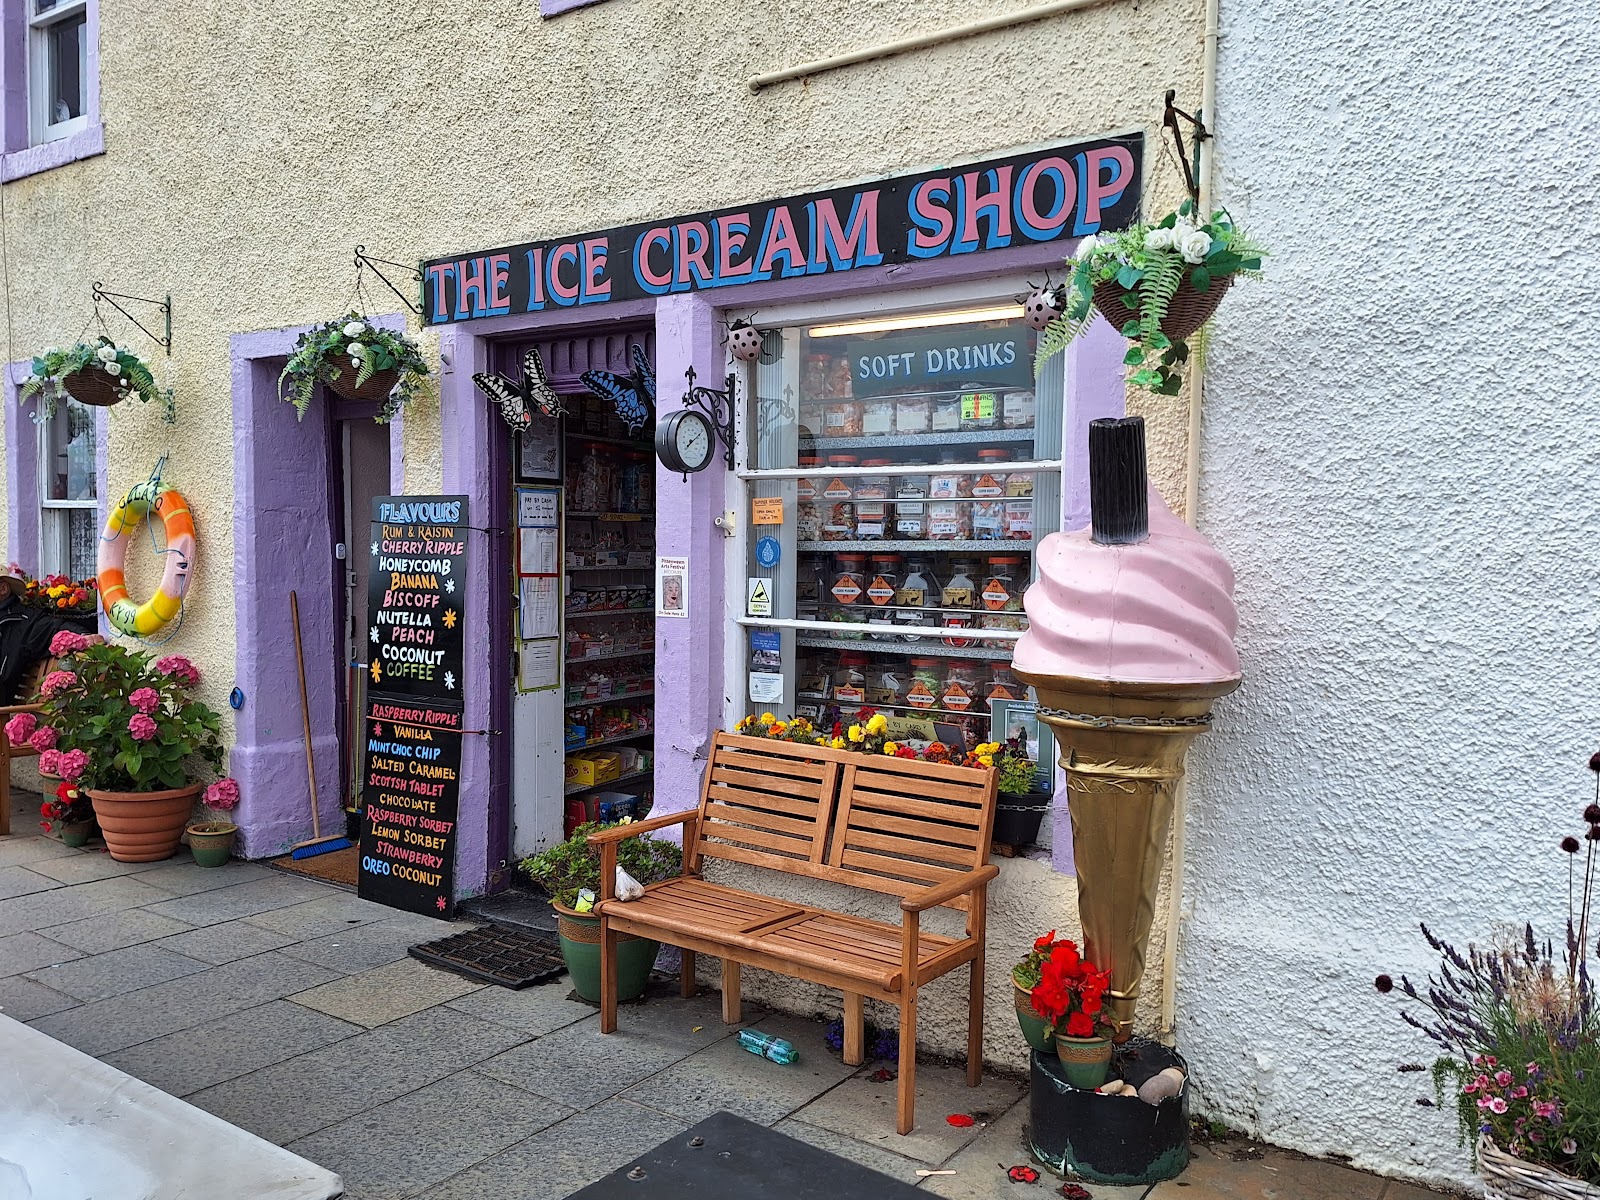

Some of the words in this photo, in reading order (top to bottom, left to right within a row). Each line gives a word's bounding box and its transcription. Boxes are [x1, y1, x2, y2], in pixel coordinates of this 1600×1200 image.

[425, 254, 511, 324] THE
[524, 237, 612, 312] ICE
[632, 188, 884, 294] CREAM
[906, 144, 1135, 258] SHOP
[859, 351, 916, 379] SOFT
[926, 340, 1016, 374] DRINKS
[379, 500, 461, 524] FLAVOURS
[382, 525, 402, 539] RUM
[407, 526, 415, 538] &
[418, 526, 454, 541] RAISIN
[382, 540, 424, 554] CHERRY
[425, 540, 464, 556] RIPPLE
[379, 556, 451, 577] HONEYCOMB
[390, 572, 439, 591] BANANA
[383, 590, 441, 608] BISCOFF
[377, 610, 432, 627] NUTELLA
[392, 626, 435, 645] PEACH
[382, 643, 446, 665] COCONUT
[387, 663, 436, 681] COFFEE
[372, 703, 424, 721] RASPBERRY
[425, 710, 458, 726] RIPPLE
[393, 724, 433, 741] VANILLA
[368, 739, 391, 754] MINT
[391, 742, 413, 757] CHOC
[415, 745, 441, 760] CHIP
[371, 755, 404, 772] SALTED
[409, 761, 456, 780] CARAMEL
[409, 779, 445, 797] TABLET
[379, 793, 436, 813] CHOCOLATE
[367, 804, 417, 828] RASPBERRY
[419, 816, 453, 834] SORBET
[371, 822, 400, 841] LEMON
[404, 832, 447, 851] SORBET
[376, 841, 443, 869] STRAWBERRY
[362, 856, 390, 876] OREO
[392, 863, 443, 887] COCONUT
